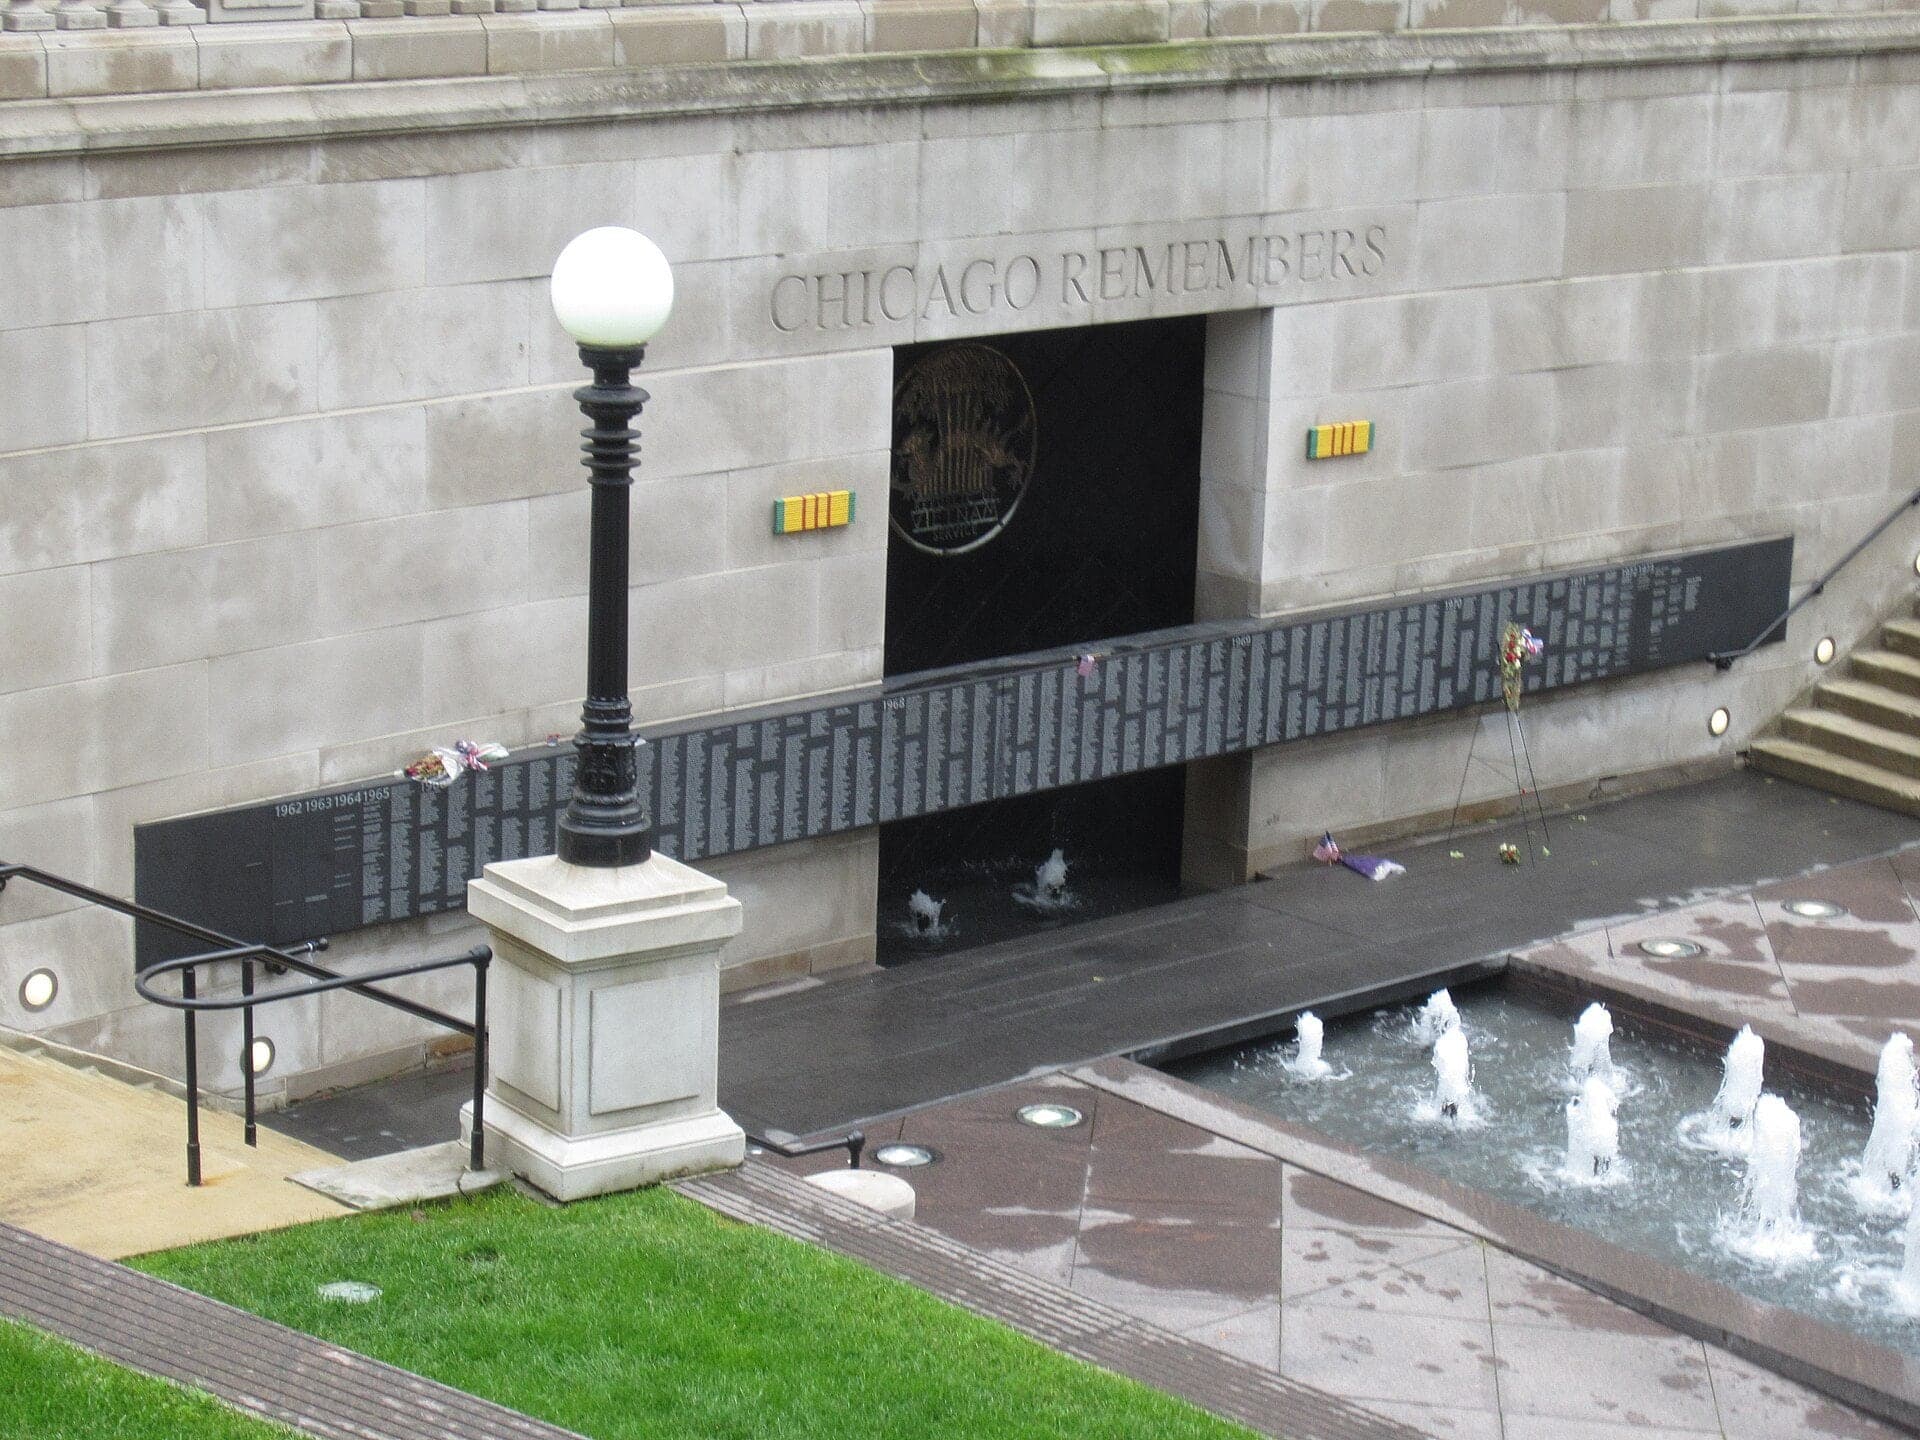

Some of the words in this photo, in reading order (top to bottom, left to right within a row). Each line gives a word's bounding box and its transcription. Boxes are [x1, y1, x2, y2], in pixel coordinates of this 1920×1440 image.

[769, 253, 1042, 333] CHICAGO
[1060, 224, 1388, 306] REMEMBERS
[883, 696, 905, 711] 1968
[275, 802, 302, 817] 1962
[305, 796, 332, 812] 1963
[335, 791, 361, 807] 1964
[363, 786, 390, 802] 1965
